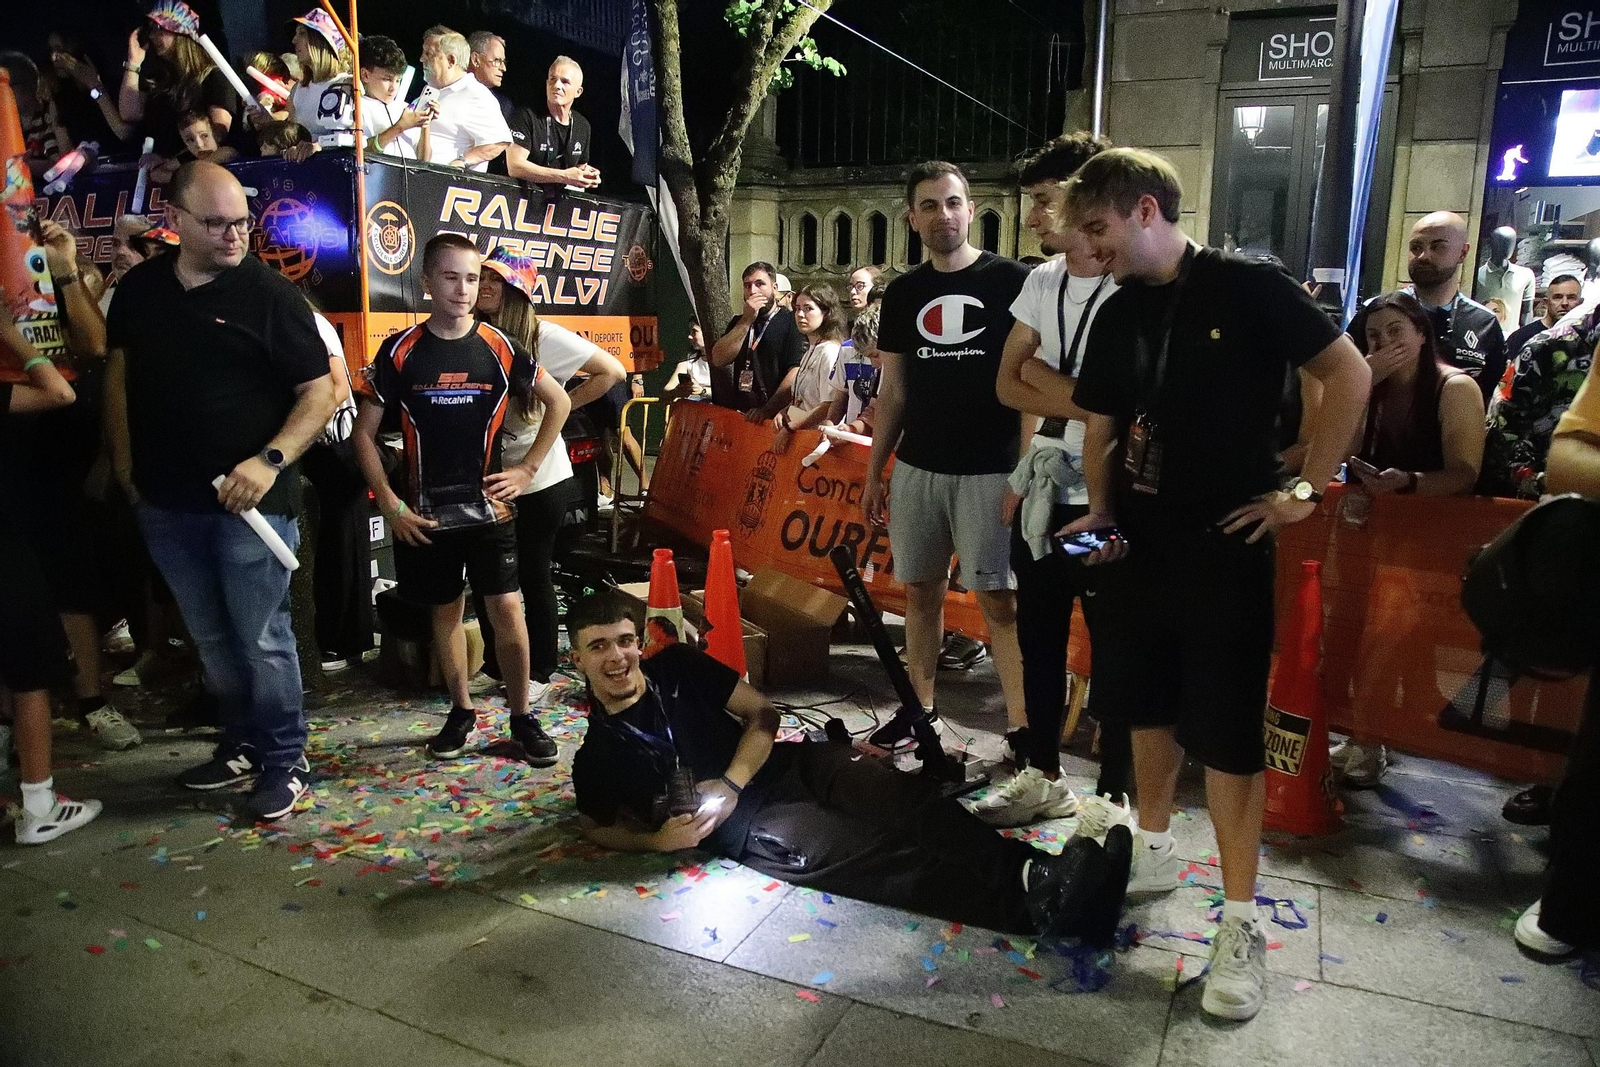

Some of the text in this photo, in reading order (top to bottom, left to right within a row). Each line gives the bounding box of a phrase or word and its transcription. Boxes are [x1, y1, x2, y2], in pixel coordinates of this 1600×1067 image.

[1558, 10, 1600, 41] SH
[1268, 31, 1334, 59] SHO
[1557, 40, 1600, 53] MULTI
[1268, 58, 1334, 70] MULTIMARC
[440, 186, 621, 243] RALLYE
[437, 229, 615, 273] UENSE
[594, 333, 623, 343] DEPORTE
[917, 346, 985, 360] Champion
[438, 395, 466, 405] Recalvi
[797, 463, 865, 505] Conc
[781, 509, 892, 575] OURE
[1265, 730, 1300, 760] ZONE
